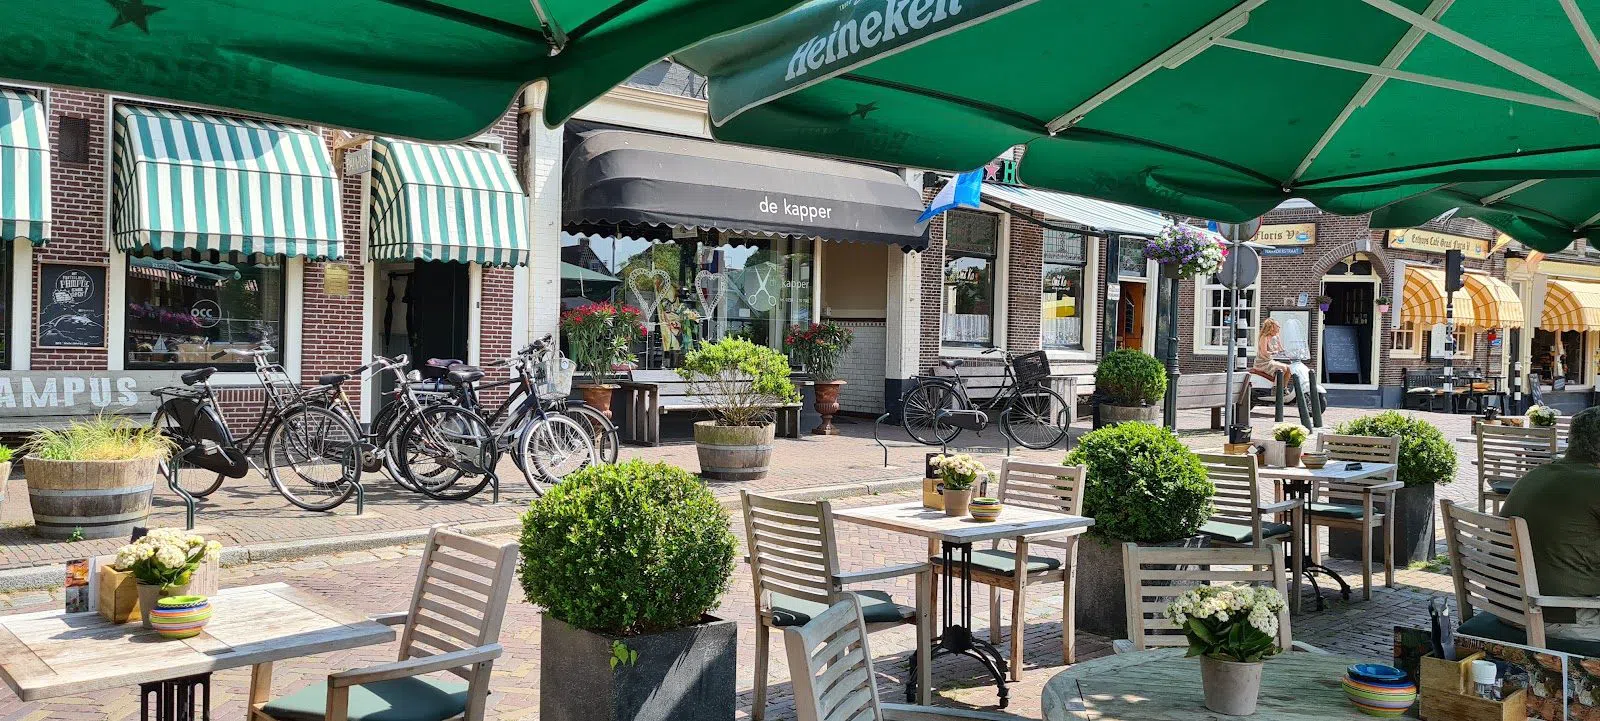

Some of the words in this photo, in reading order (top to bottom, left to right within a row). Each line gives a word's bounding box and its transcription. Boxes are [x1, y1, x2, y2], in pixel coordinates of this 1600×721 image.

[785, 0, 962, 81] Heineken
[759, 196, 778, 213] de
[783, 198, 832, 222] kapper
